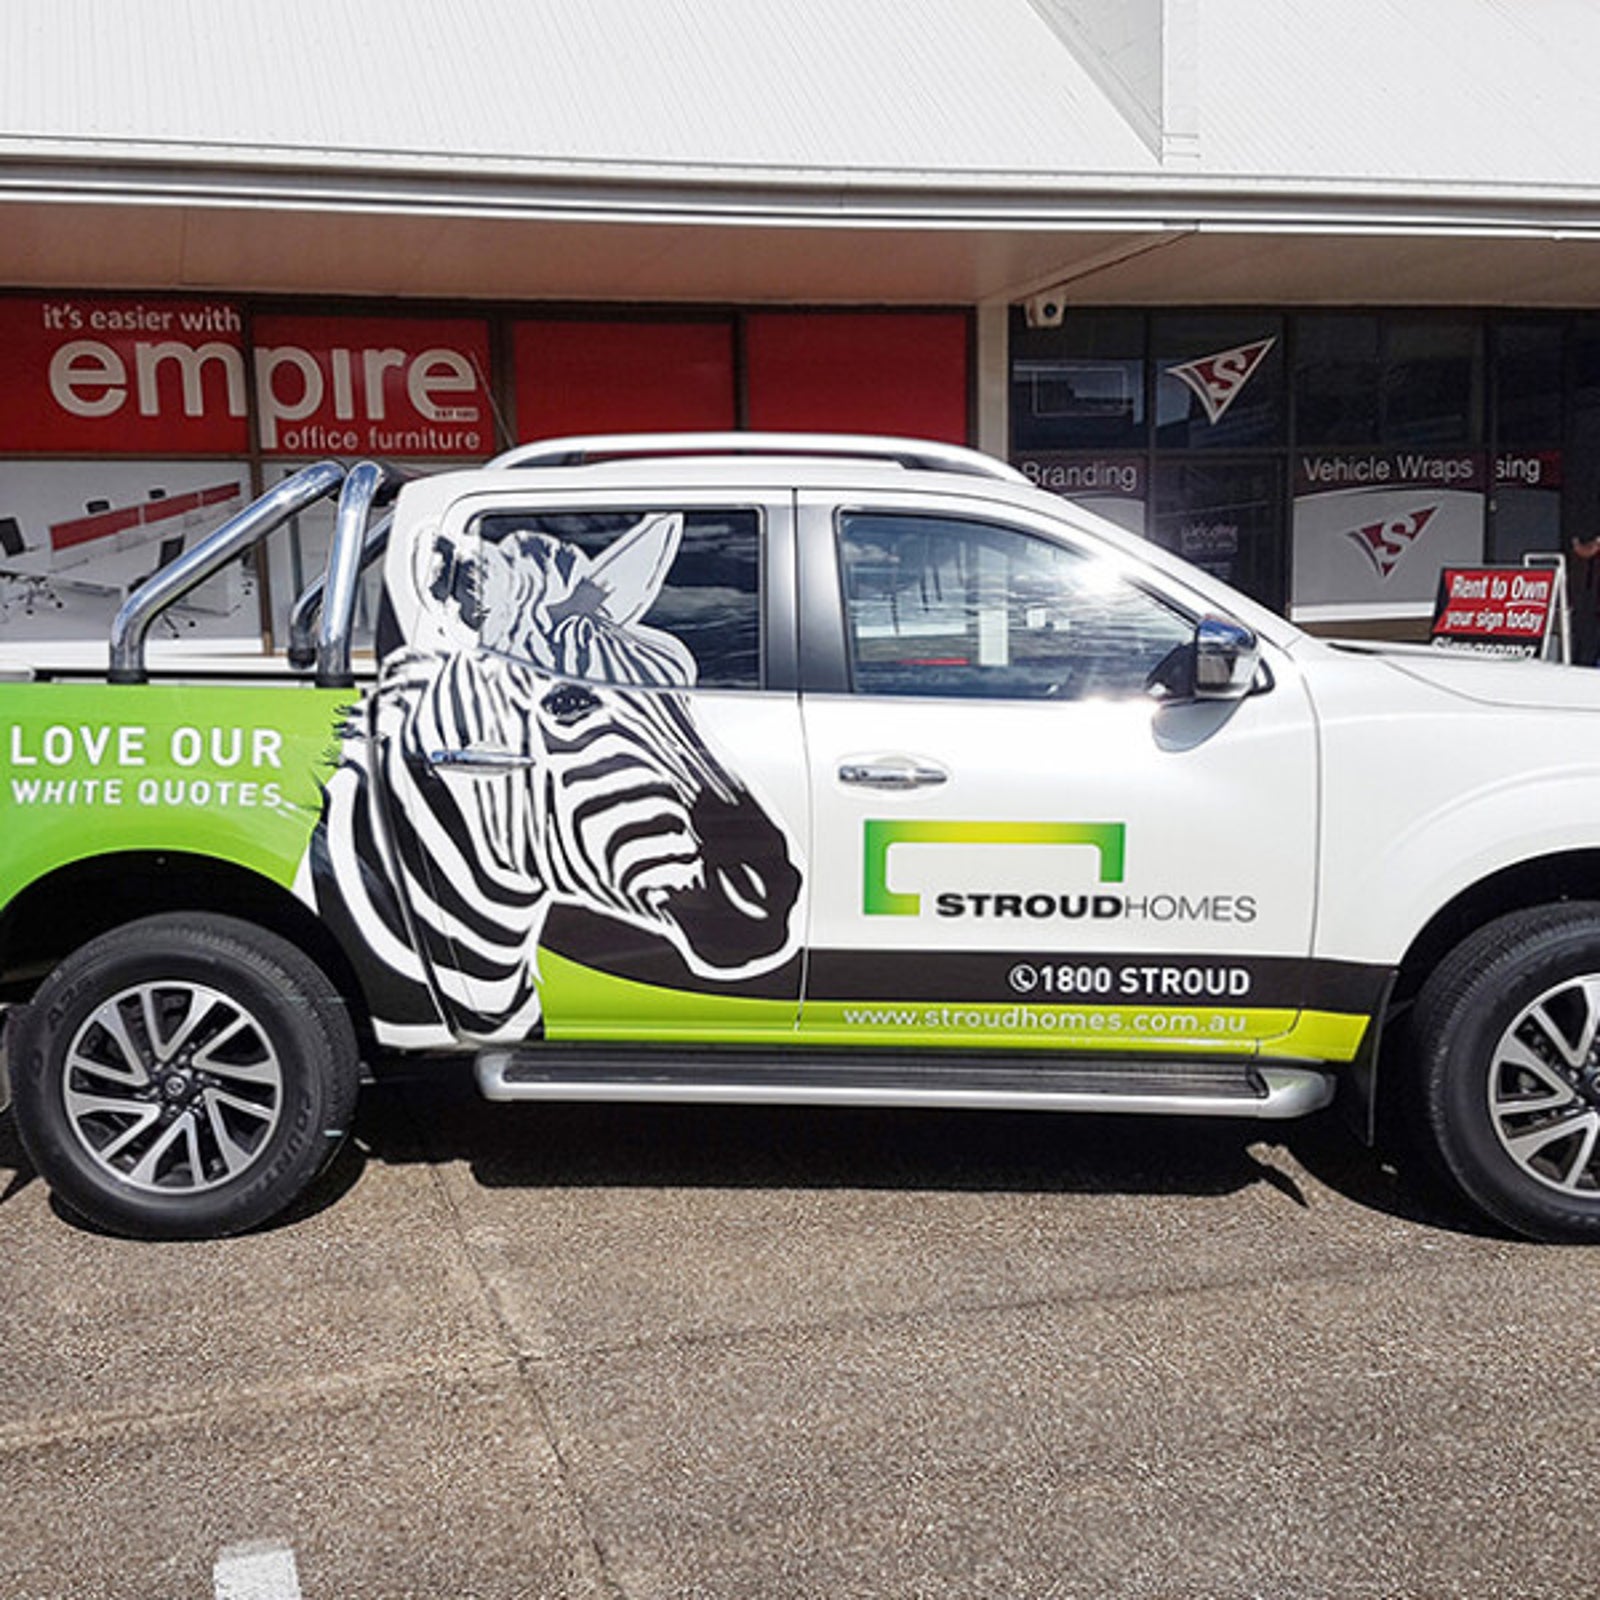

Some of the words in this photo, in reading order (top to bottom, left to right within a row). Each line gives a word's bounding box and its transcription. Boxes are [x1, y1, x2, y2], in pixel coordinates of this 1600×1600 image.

[43, 304, 83, 329] it's
[90, 306, 172, 330] easier
[180, 307, 241, 331] with
[48, 340, 478, 449] empire
[284, 427, 359, 450] office
[368, 426, 481, 451] furniture
[1022, 460, 1137, 492] Branding
[1304, 456, 1390, 481] Vehicle
[1397, 455, 1474, 485] Wraps
[1450, 575, 1489, 599] Rent
[1491, 576, 1508, 599] to
[1510, 575, 1549, 600] Own
[1445, 611, 1475, 630] your
[1476, 607, 1504, 632] sign
[1506, 609, 1544, 633] today
[10, 725, 147, 766] LOVE
[170, 726, 284, 769] OUR
[11, 779, 124, 805] WHITE
[138, 779, 282, 808] QUOTES
[1040, 966, 1112, 993] 1800
[1119, 967, 1250, 996] STROUD
[843, 1004, 1247, 1034] www.stroudhomes.com.au
